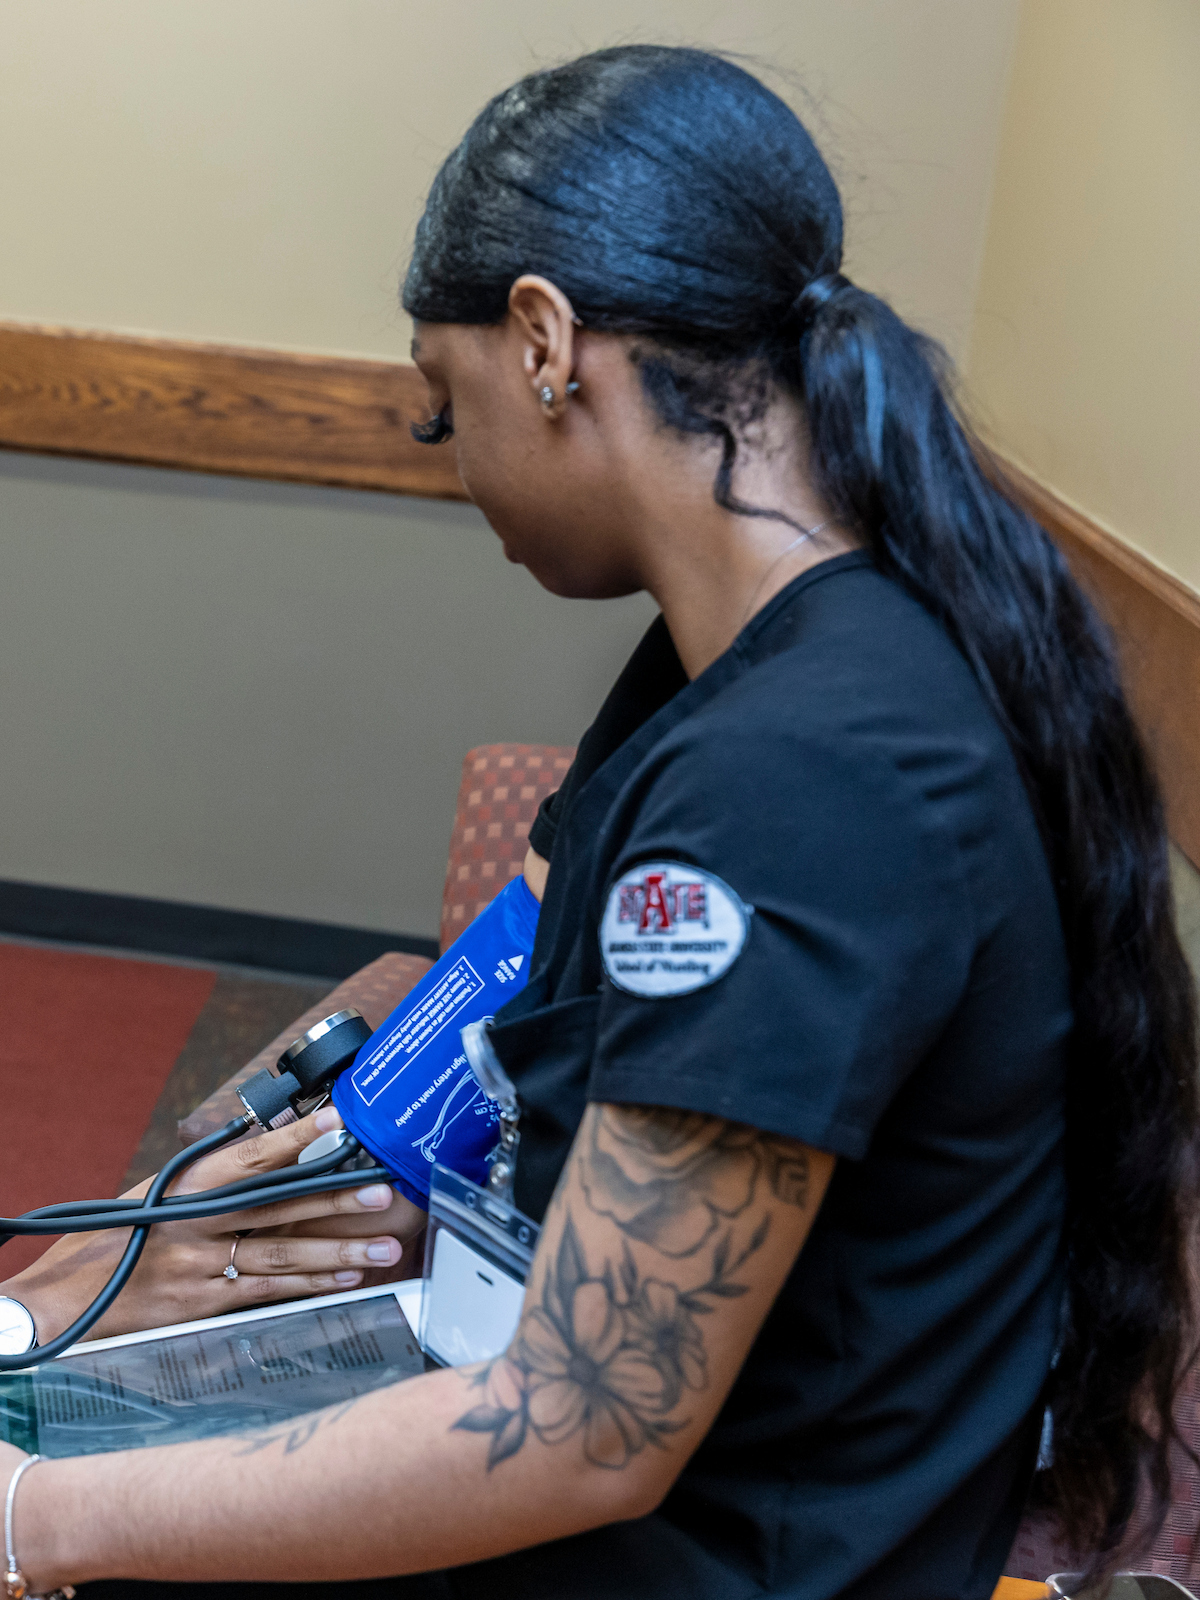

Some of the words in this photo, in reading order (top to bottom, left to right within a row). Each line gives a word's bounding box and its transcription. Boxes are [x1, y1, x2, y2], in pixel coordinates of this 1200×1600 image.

[434, 1068, 453, 1087] artery
[418, 1086, 435, 1103] mark
[412, 1102, 421, 1110] to
[396, 1107, 413, 1127] pinky
